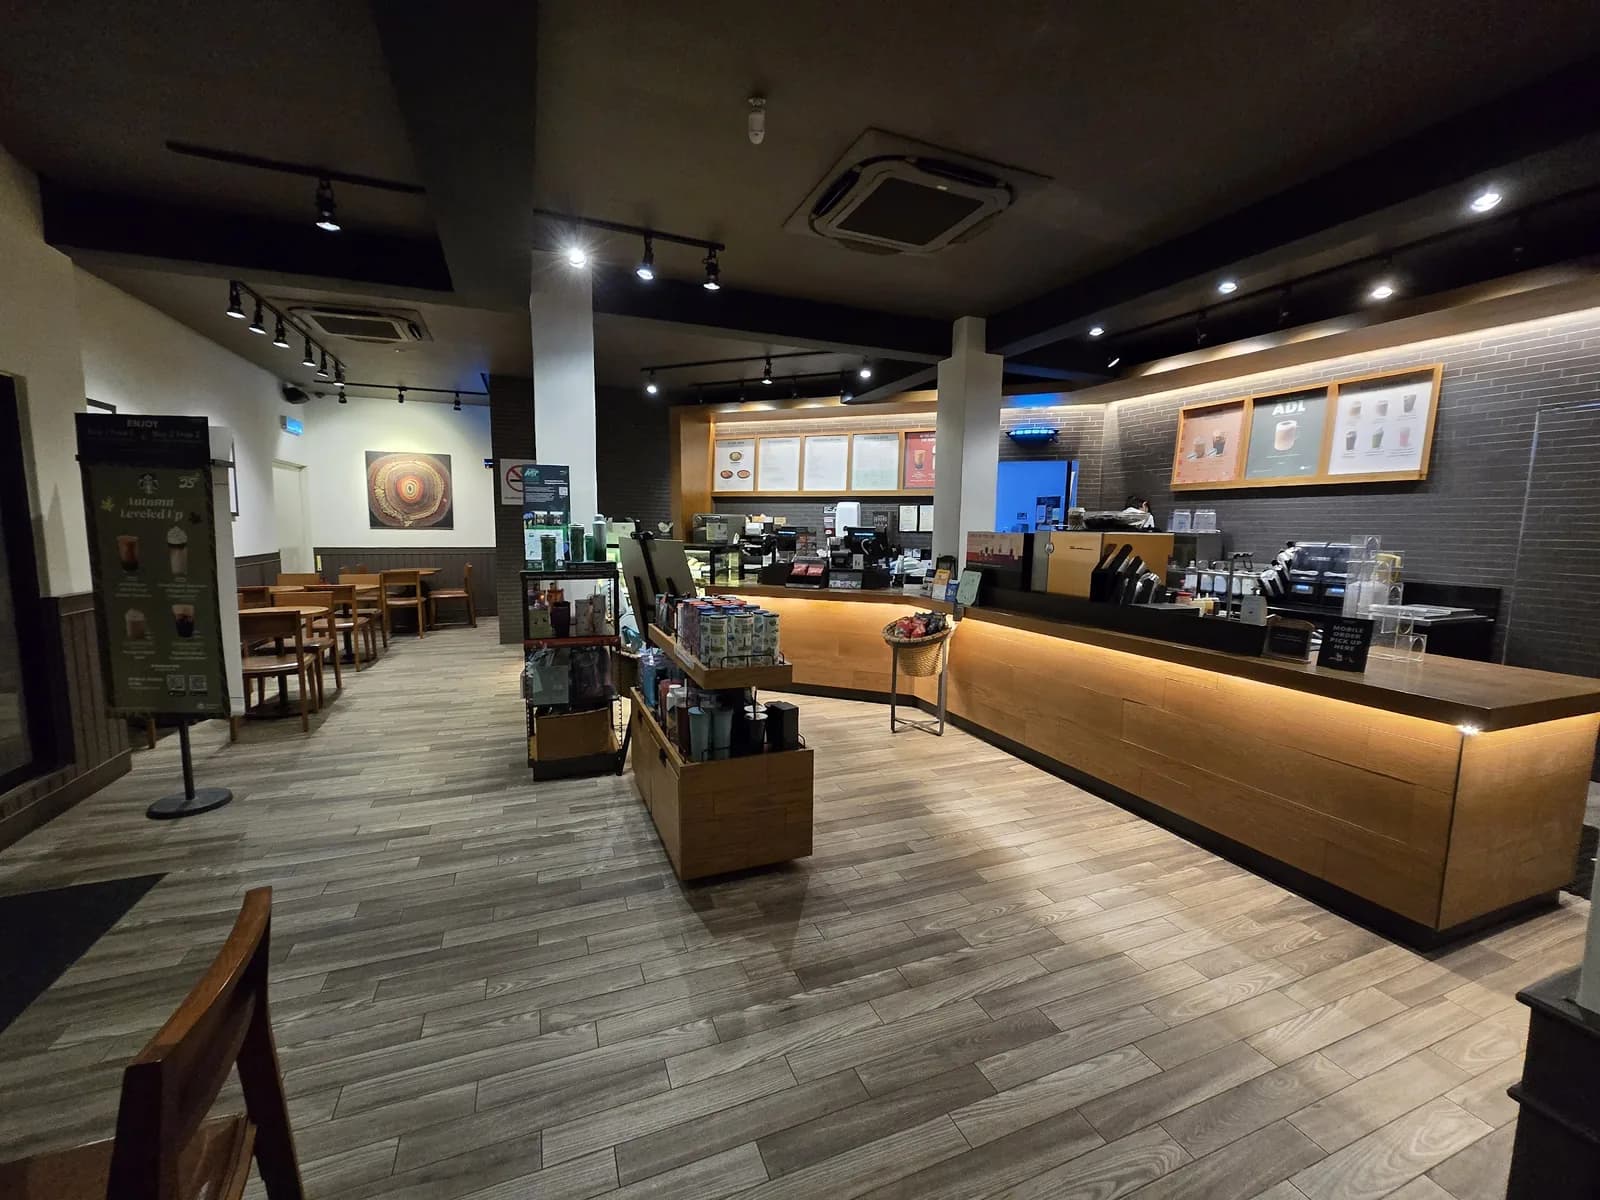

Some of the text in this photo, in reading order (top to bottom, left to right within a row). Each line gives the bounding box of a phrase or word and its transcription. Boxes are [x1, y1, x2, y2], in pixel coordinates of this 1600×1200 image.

[127, 419, 159, 428] ENJOY
[129, 497, 175, 507] Autumn
[120, 508, 165, 520] Leveled
[1332, 625, 1364, 633] MOBILE
[1332, 631, 1362, 639] ORDER
[1330, 637, 1348, 645] PICK
